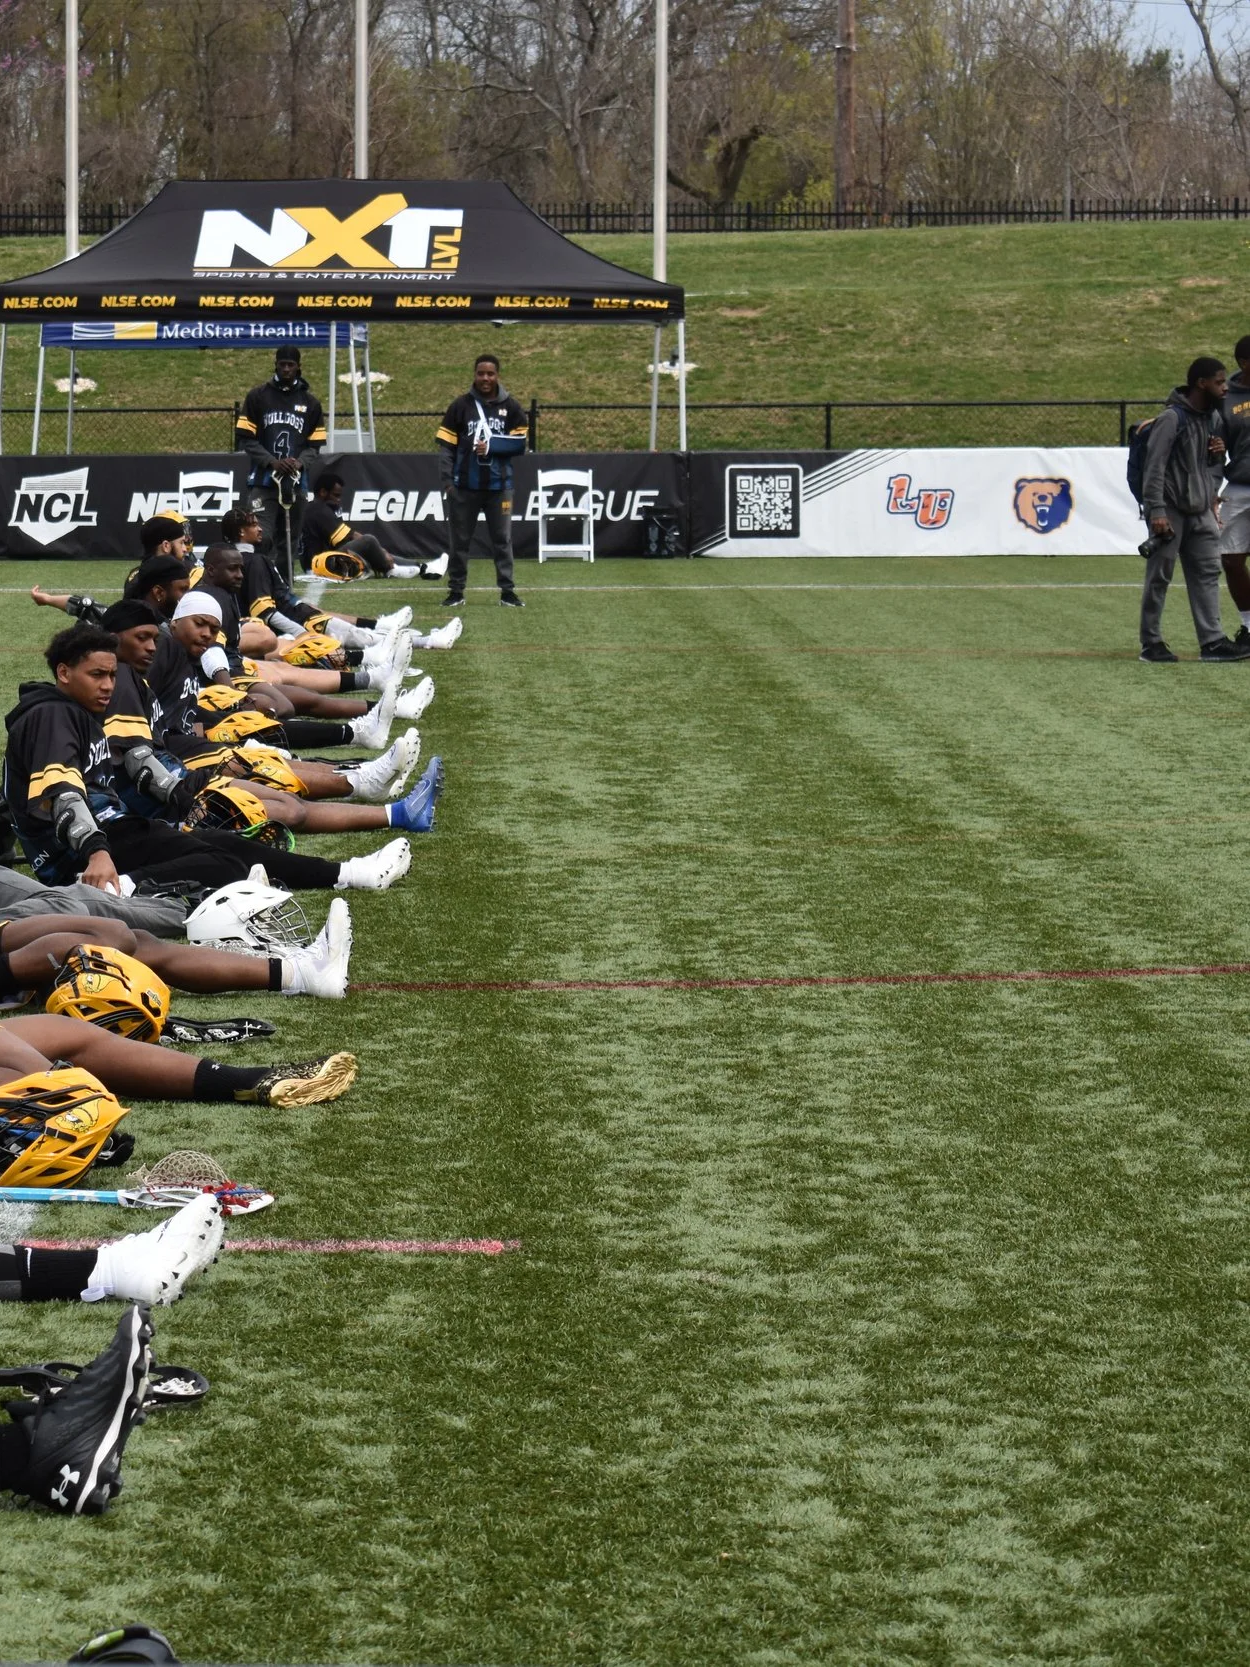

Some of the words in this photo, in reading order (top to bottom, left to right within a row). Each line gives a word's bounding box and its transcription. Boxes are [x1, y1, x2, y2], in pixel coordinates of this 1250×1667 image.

[193, 193, 464, 269] NXT
[431, 228, 462, 269] LVL
[3, 296, 78, 309] NLSE.COM
[101, 295, 176, 308] NLSE.COM
[199, 295, 274, 308] NLSE.COM
[297, 295, 372, 308] NLSE.COM
[395, 295, 471, 308] NLSE.COM
[494, 296, 570, 308] NLSE.COM
[162, 322, 244, 339] MedStar
[250, 322, 317, 339] Health
[15, 491, 98, 524] NCL
[511, 490, 660, 521] EAGUE
[886, 473, 955, 530] LU
